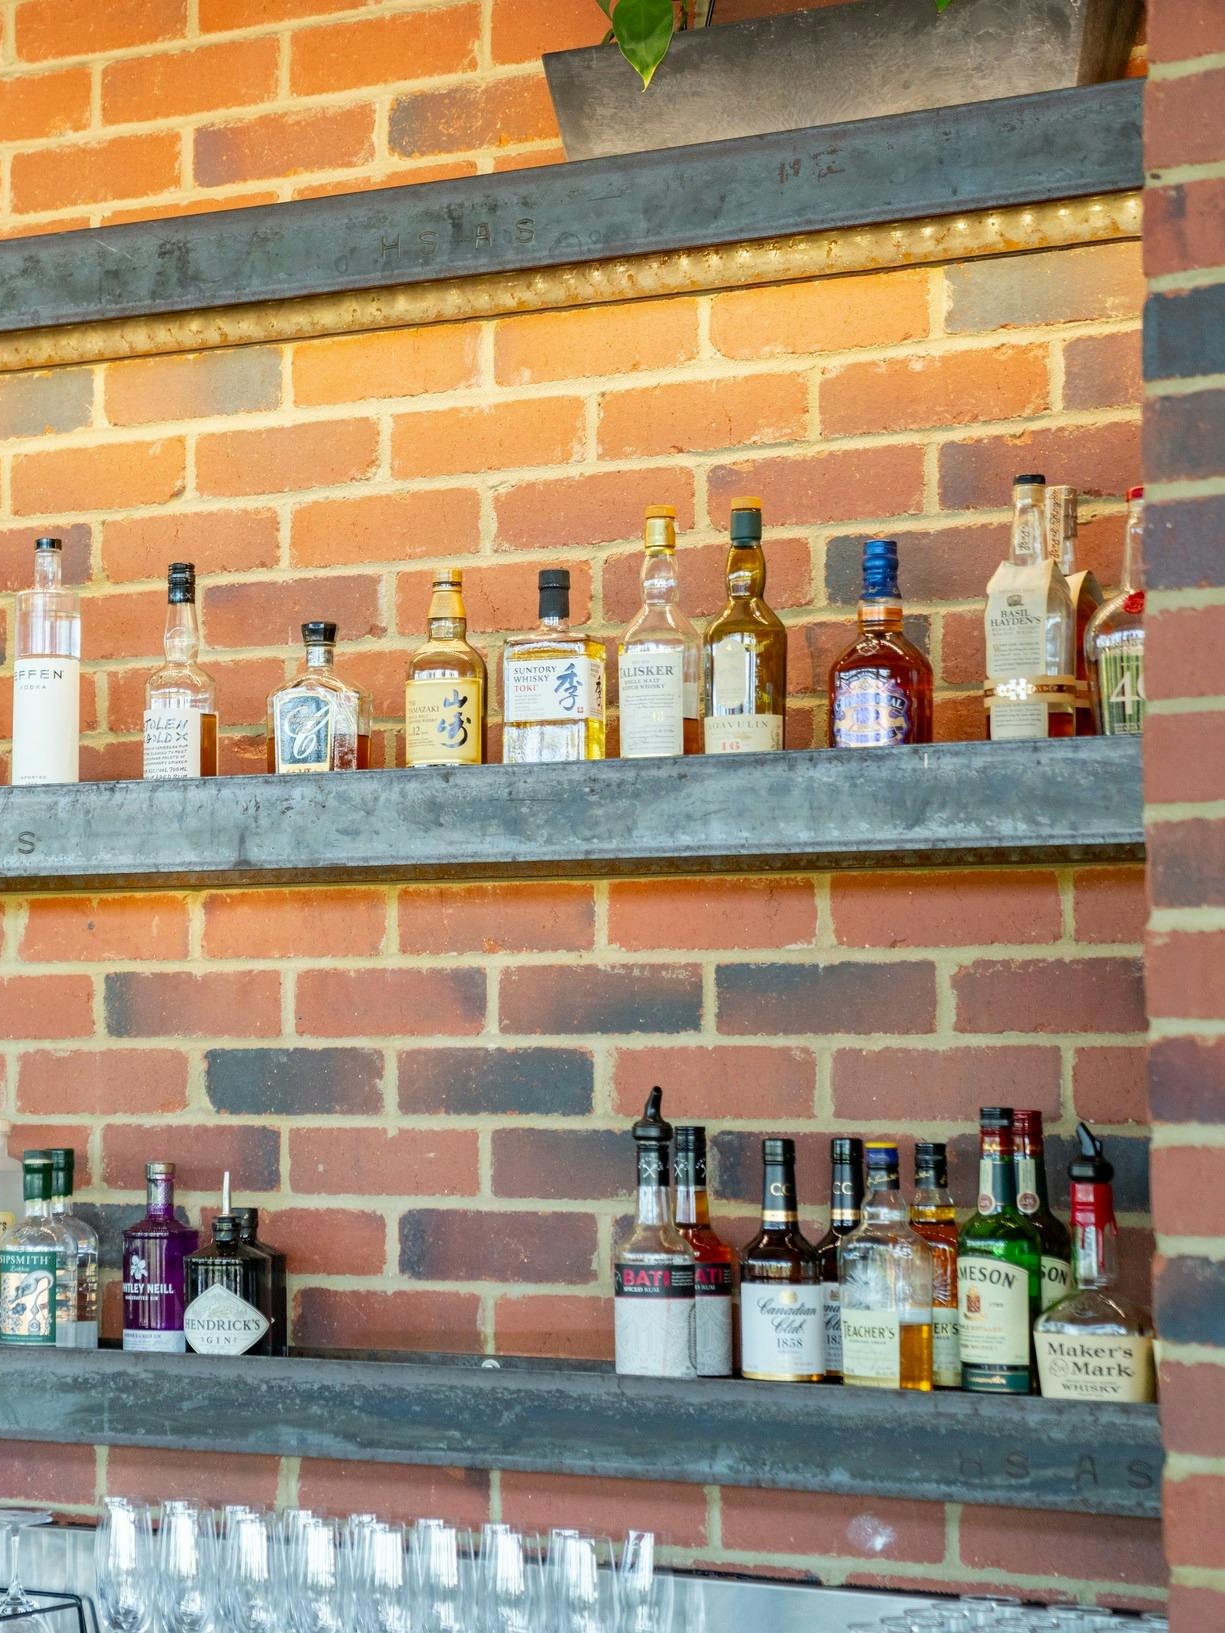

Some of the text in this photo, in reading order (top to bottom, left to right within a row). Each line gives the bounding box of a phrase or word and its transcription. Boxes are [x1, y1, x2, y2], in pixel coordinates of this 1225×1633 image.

[1001, 608, 1030, 618] BASIL
[990, 615, 1041, 627] HAYDEN'S
[514, 665, 558, 675] SUNTORY
[514, 675, 550, 684] WHISKY
[514, 684, 538, 693] TOKI
[0, 1255, 48, 1265] SIPSMITH
[622, 1268, 670, 1287] BATI
[147, 1283, 175, 1294] NEILL
[756, 1297, 817, 1318] Canadian
[184, 1318, 261, 1331] HENDRICK'S
[770, 1317, 805, 1335] Club
[843, 1320, 895, 1340] TEACHER'S
[206, 1336, 232, 1344] GIN
[776, 1338, 804, 1349] 1858
[1048, 1342, 1134, 1359] Maker's
[1071, 1361, 1133, 1378] Mark
[1061, 1383, 1120, 1393] WHISKY
